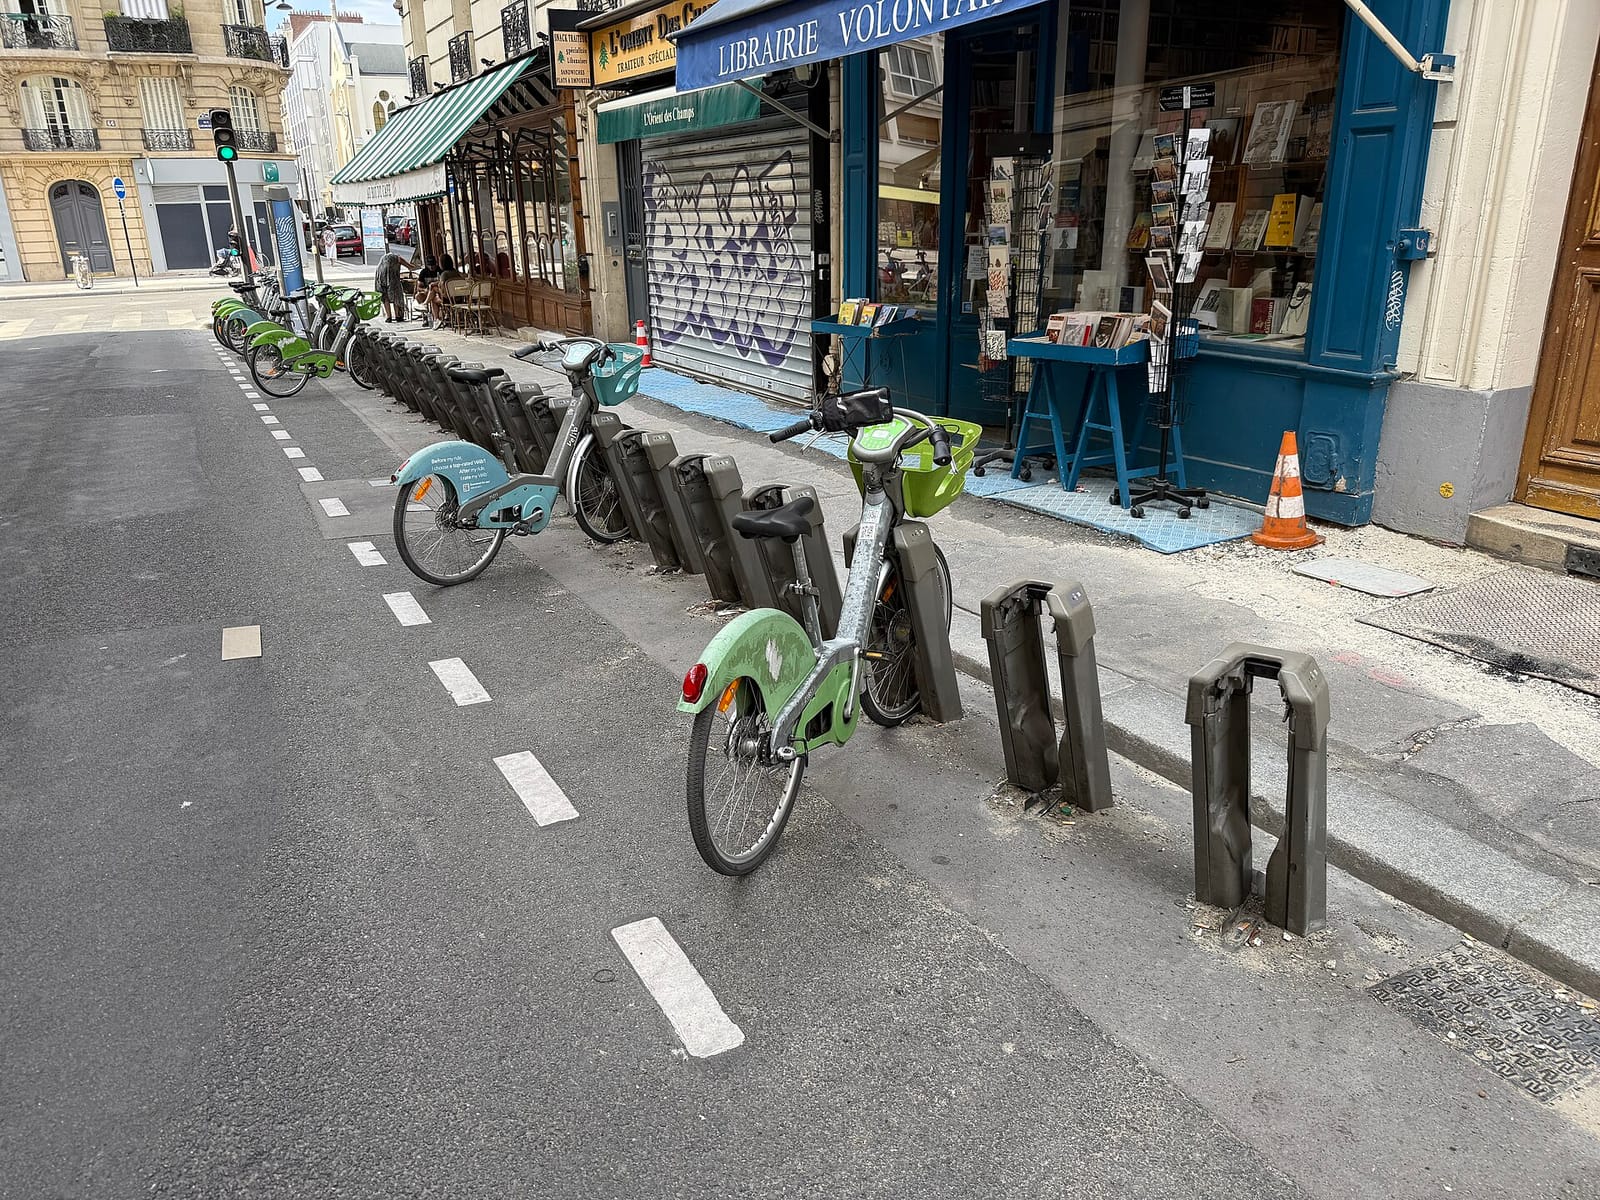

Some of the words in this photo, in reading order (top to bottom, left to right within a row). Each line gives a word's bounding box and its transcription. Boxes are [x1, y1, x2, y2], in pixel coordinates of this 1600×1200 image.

[718, 20, 819, 77] LIBRAIRIE
[838, 0, 1002, 47] VOLONT
[617, 55, 645, 73] TRAITEUR
[648, 47, 677, 65] SPÉCIALI
[643, 111, 664, 126] L'Orient
[663, 109, 673, 123] des
[673, 106, 695, 122] Champs
